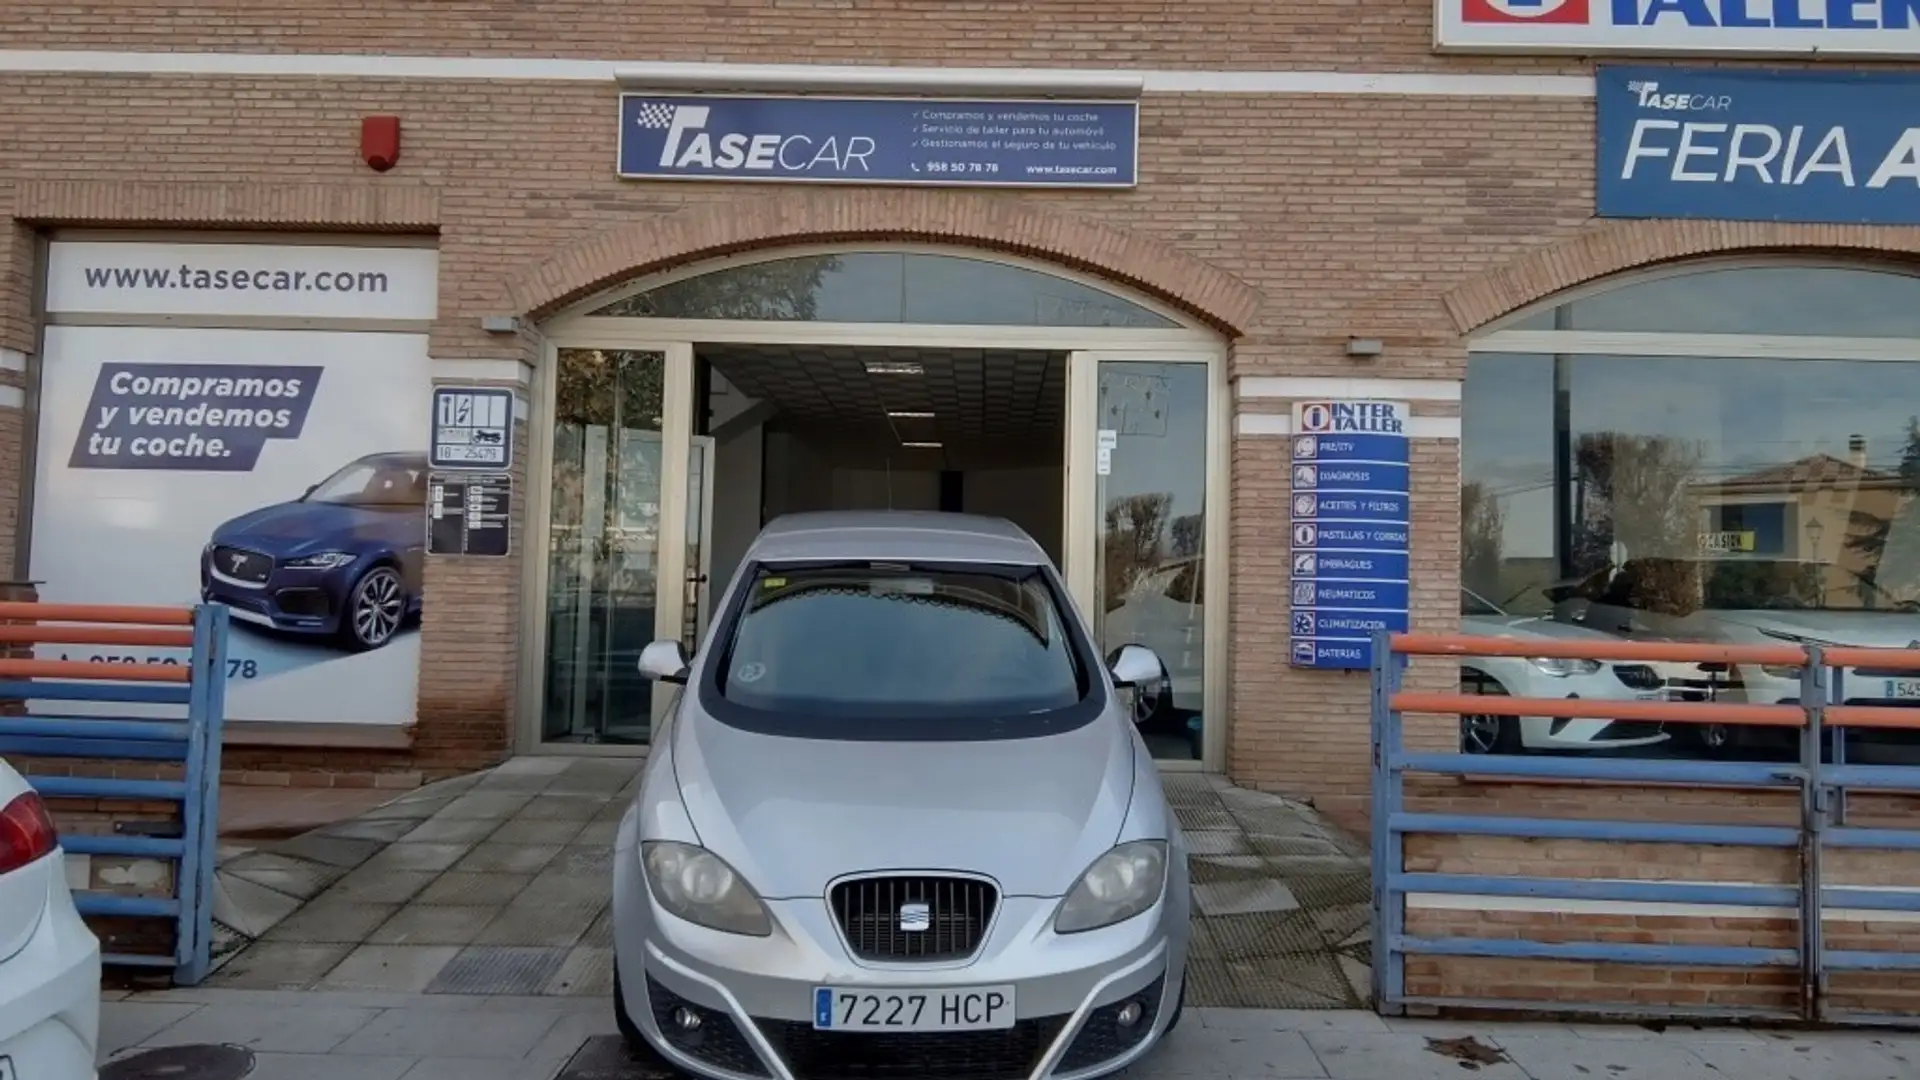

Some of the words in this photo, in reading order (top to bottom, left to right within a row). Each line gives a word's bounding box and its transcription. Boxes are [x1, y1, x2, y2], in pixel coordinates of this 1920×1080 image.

[1638, 82, 1731, 111] TASECAR
[922, 111, 984, 122] Compramos
[998, 112, 1050, 122] vendemos
[1053, 112, 1064, 121] tu
[1067, 112, 1098, 122] coche
[659, 105, 875, 170] TASECAR
[922, 125, 962, 134] Servicio
[966, 125, 979, 135] de
[982, 126, 1009, 135] taller
[1012, 127, 1035, 137] para
[1038, 127, 1049, 136] tu
[921, 139, 988, 149] Gestionamos
[991, 140, 1001, 149] el
[1003, 140, 1039, 151] seguro
[1042, 140, 1055, 150] de
[1058, 141, 1069, 150] tu
[1620, 119, 1855, 187] FERIA
[926, 162, 948, 172] 958
[950, 162, 965, 172] 50
[968, 163, 982, 173] 78
[985, 163, 999, 173] 78
[1026, 164, 1117, 175] www.tasecar.com
[85, 265, 388, 292] www.tasecar.com
[110, 371, 302, 400] Compramos
[96, 407, 117, 428] y
[128, 405, 291, 428] vendemos
[1331, 402, 1395, 417] INTER
[1332, 417, 1402, 433] TALLER
[88, 434, 121, 456] tu
[130, 434, 231, 457] coche.
[1320, 471, 1370, 481] DIAGNOSIS
[1320, 500, 1357, 510] ACEITES
[1368, 502, 1399, 512] FILTROS
[1318, 529, 1365, 541] PASTILLAS
[1319, 559, 1373, 570] EMBRAGUES
[1318, 588, 1376, 600] NEUMATICOS
[1318, 648, 1361, 659] BATERIAS
[227, 659, 257, 679] 78
[839, 994, 926, 1025] 7227
[941, 993, 1004, 1024] HCP
